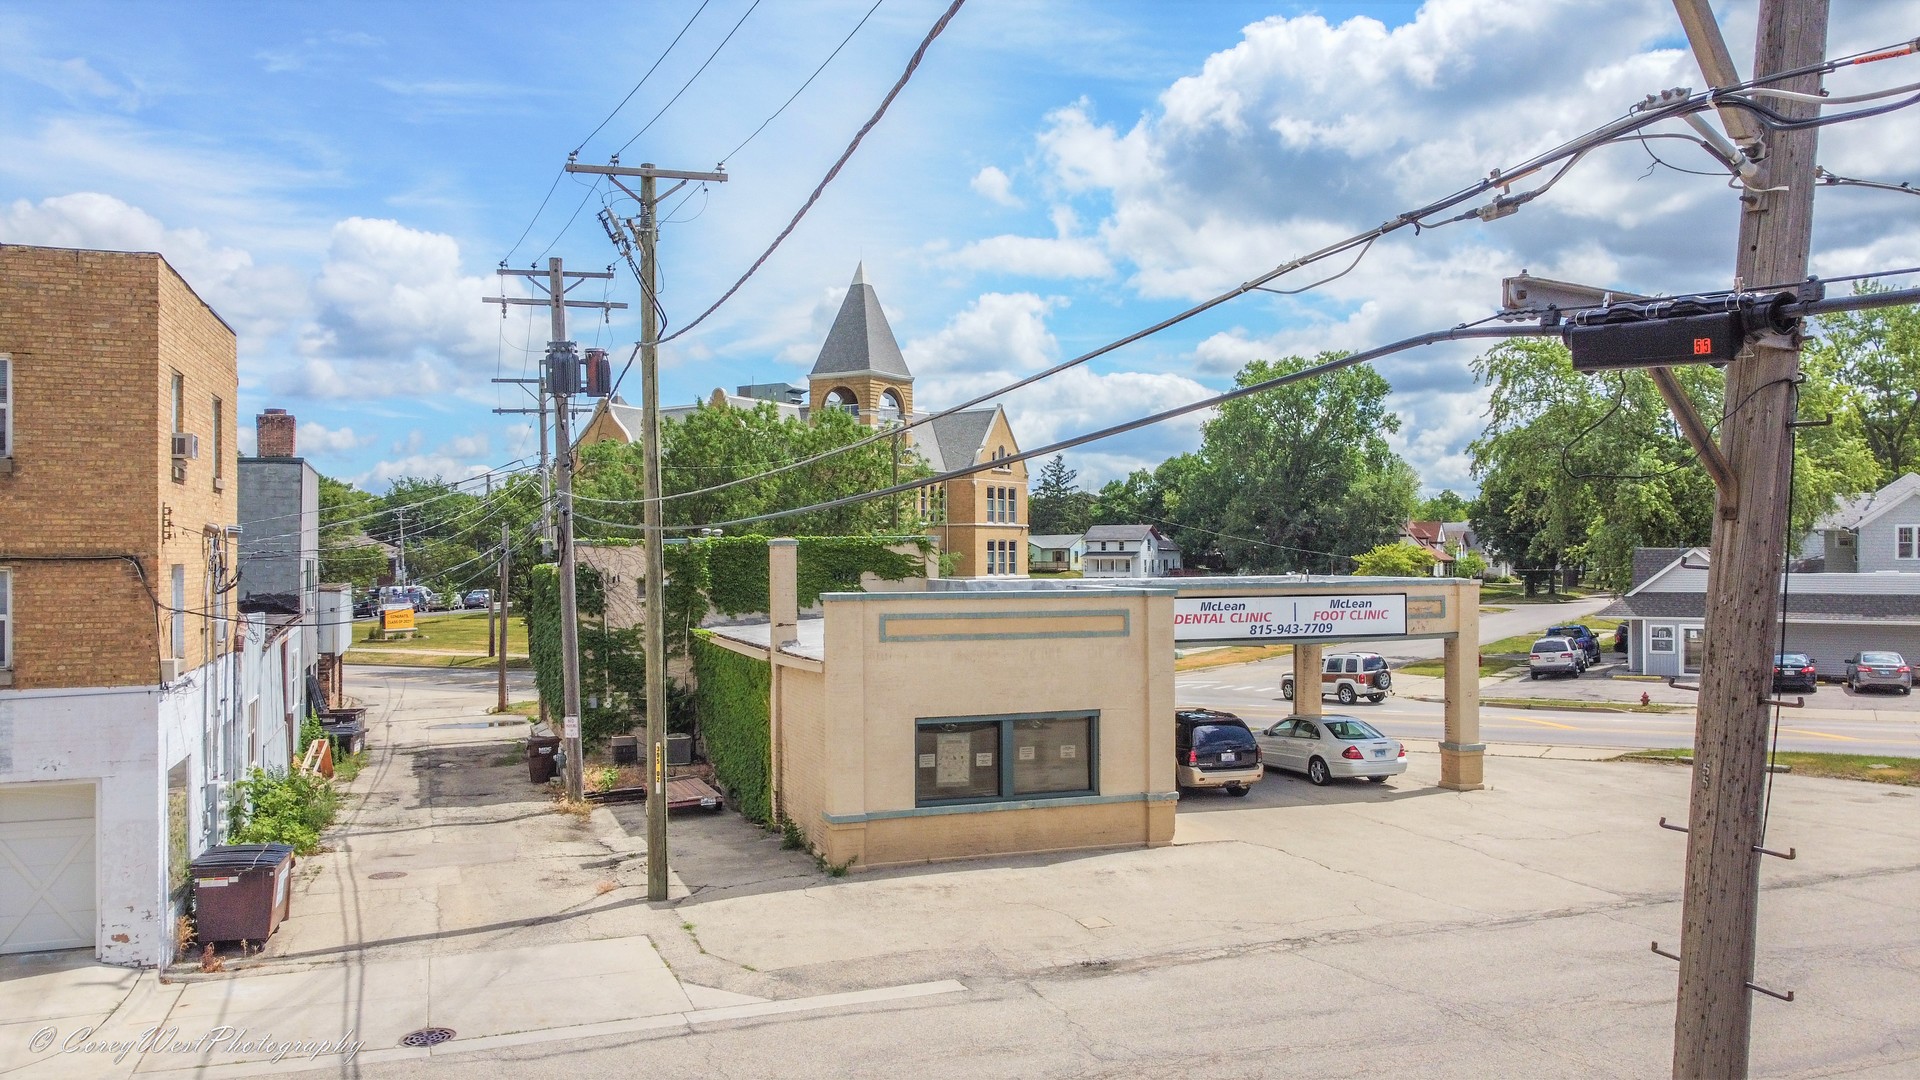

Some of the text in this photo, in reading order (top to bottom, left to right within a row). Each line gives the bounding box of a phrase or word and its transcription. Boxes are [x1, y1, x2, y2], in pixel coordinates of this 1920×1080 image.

[1696, 339, 1709, 353] 55
[1200, 601, 1246, 612] McLean
[1329, 599, 1372, 609] McLean
[1174, 612, 1272, 625] DENTAL CLINIC
[1313, 609, 1389, 621] FOOT CLINIC
[1249, 623, 1333, 635] 815-943-7709
